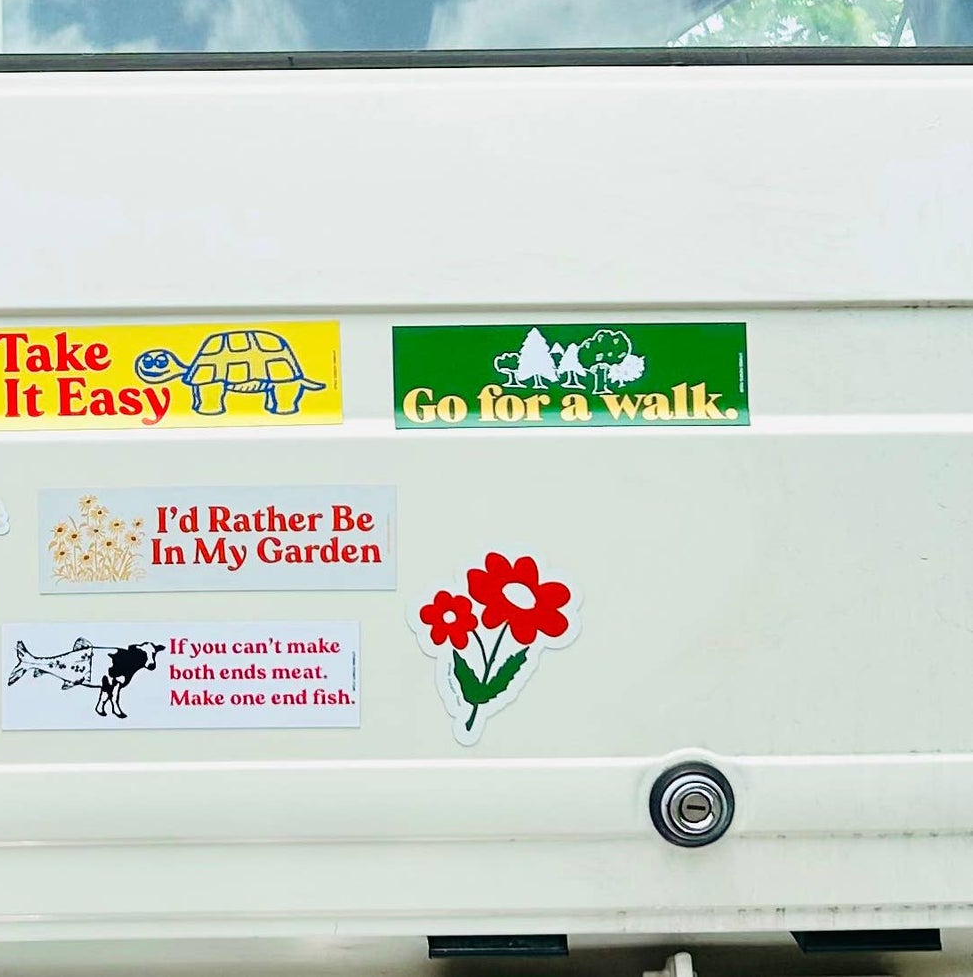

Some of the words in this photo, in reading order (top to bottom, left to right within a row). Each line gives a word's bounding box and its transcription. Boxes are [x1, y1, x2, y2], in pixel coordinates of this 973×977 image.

[3, 377, 43, 418] It
[57, 376, 171, 426] Easy
[402, 387, 468, 424] Go
[477, 384, 550, 423] for
[560, 393, 593, 423] a
[600, 381, 739, 422] walk.
[156, 505, 200, 534] I’d
[208, 505, 323, 533] Rather
[331, 505, 375, 532] Be
[151, 537, 186, 565] In
[193, 536, 248, 572] My
[256, 535, 382, 564] Garden
[169, 637, 188, 655] If
[189, 641, 227, 659] you
[231, 636, 282, 655] can’t
[286, 637, 341, 654] make
[169, 663, 215, 681] both
[219, 663, 266, 680] ends
[271, 664, 328, 680] meat.
[169, 689, 225, 706] Make
[230, 692, 266, 706] one
[271, 688, 307, 706] end
[312, 687, 355, 706] fish.
